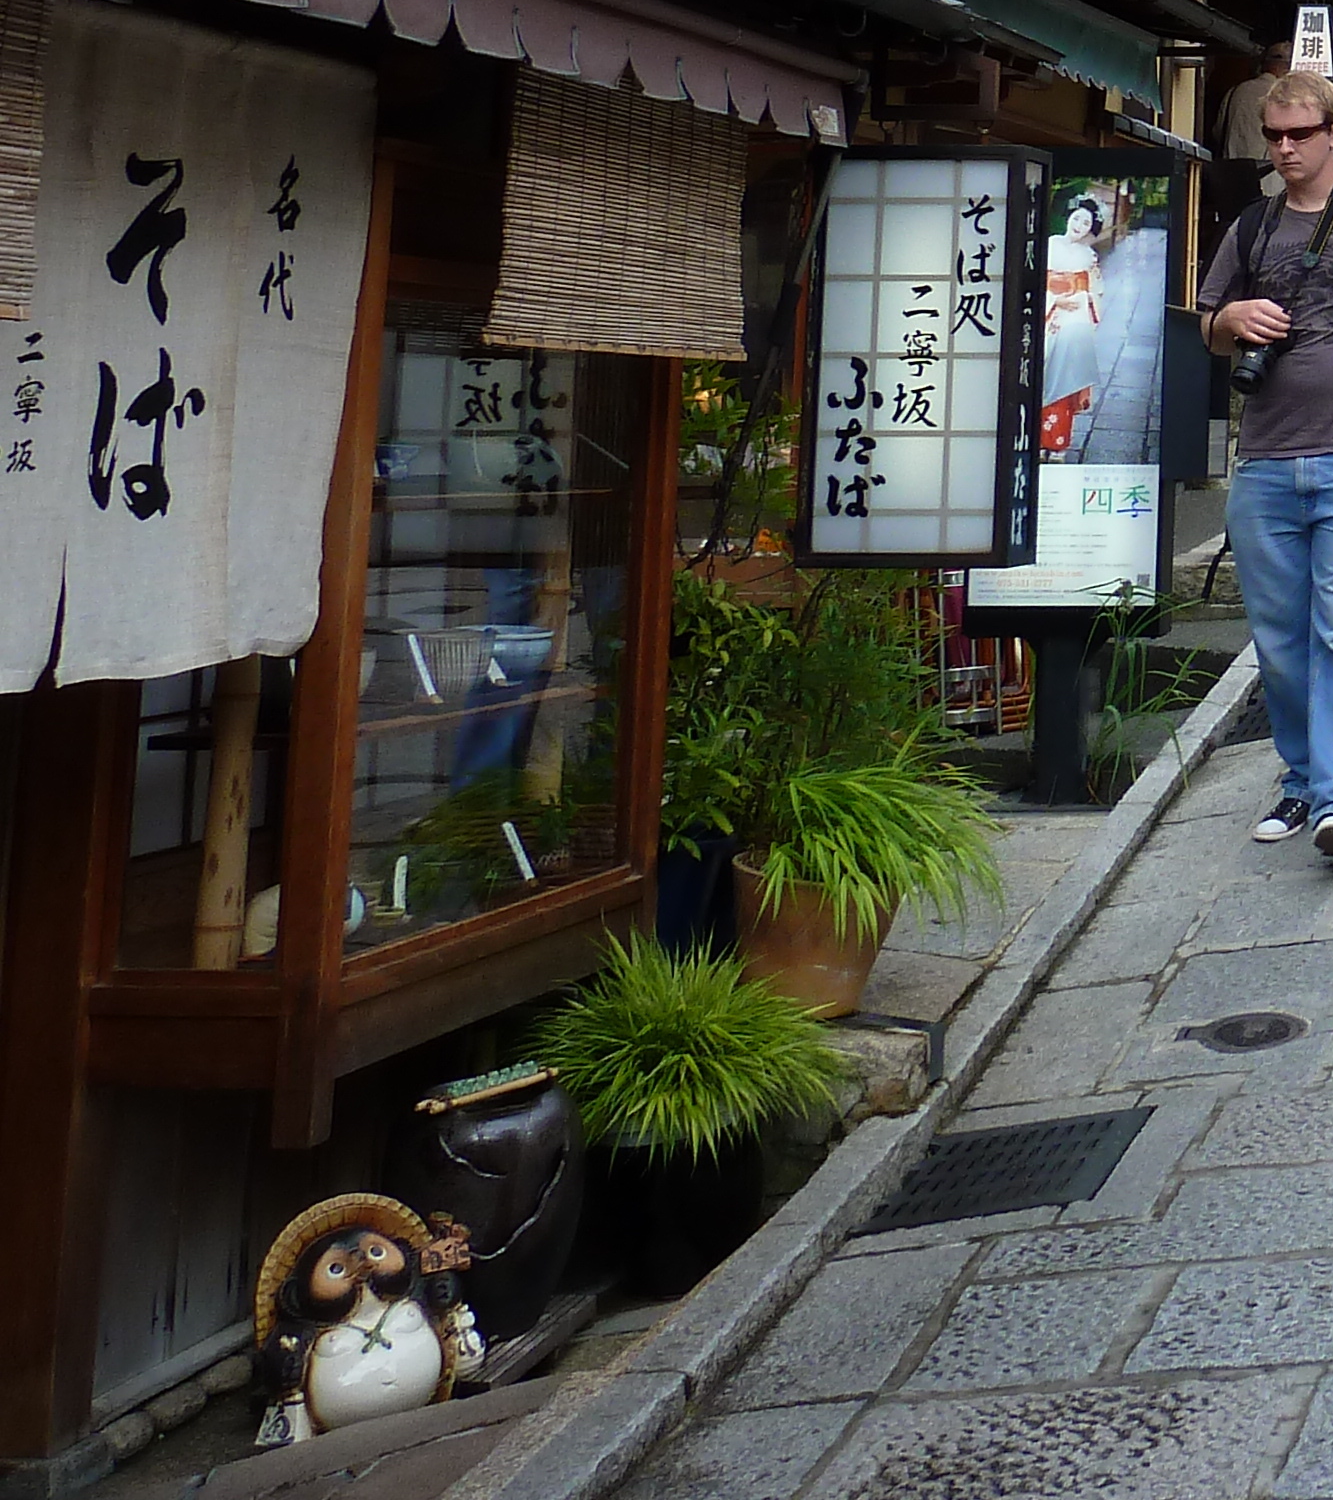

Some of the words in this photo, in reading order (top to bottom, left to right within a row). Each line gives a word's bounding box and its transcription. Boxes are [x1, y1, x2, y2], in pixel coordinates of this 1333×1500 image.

[1301, 12, 1324, 59] 珈琲
[258, 153, 302, 321] 名代
[950, 193, 996, 337] そば処
[5, 332, 45, 474] 二寧坂
[88, 152, 206, 521] そば
[892, 285, 940, 428] 二寧坂
[826, 356, 886, 519] ふたば
[1010, 403, 1031, 547] ふたば
[1082, 484, 1153, 518] 四季
